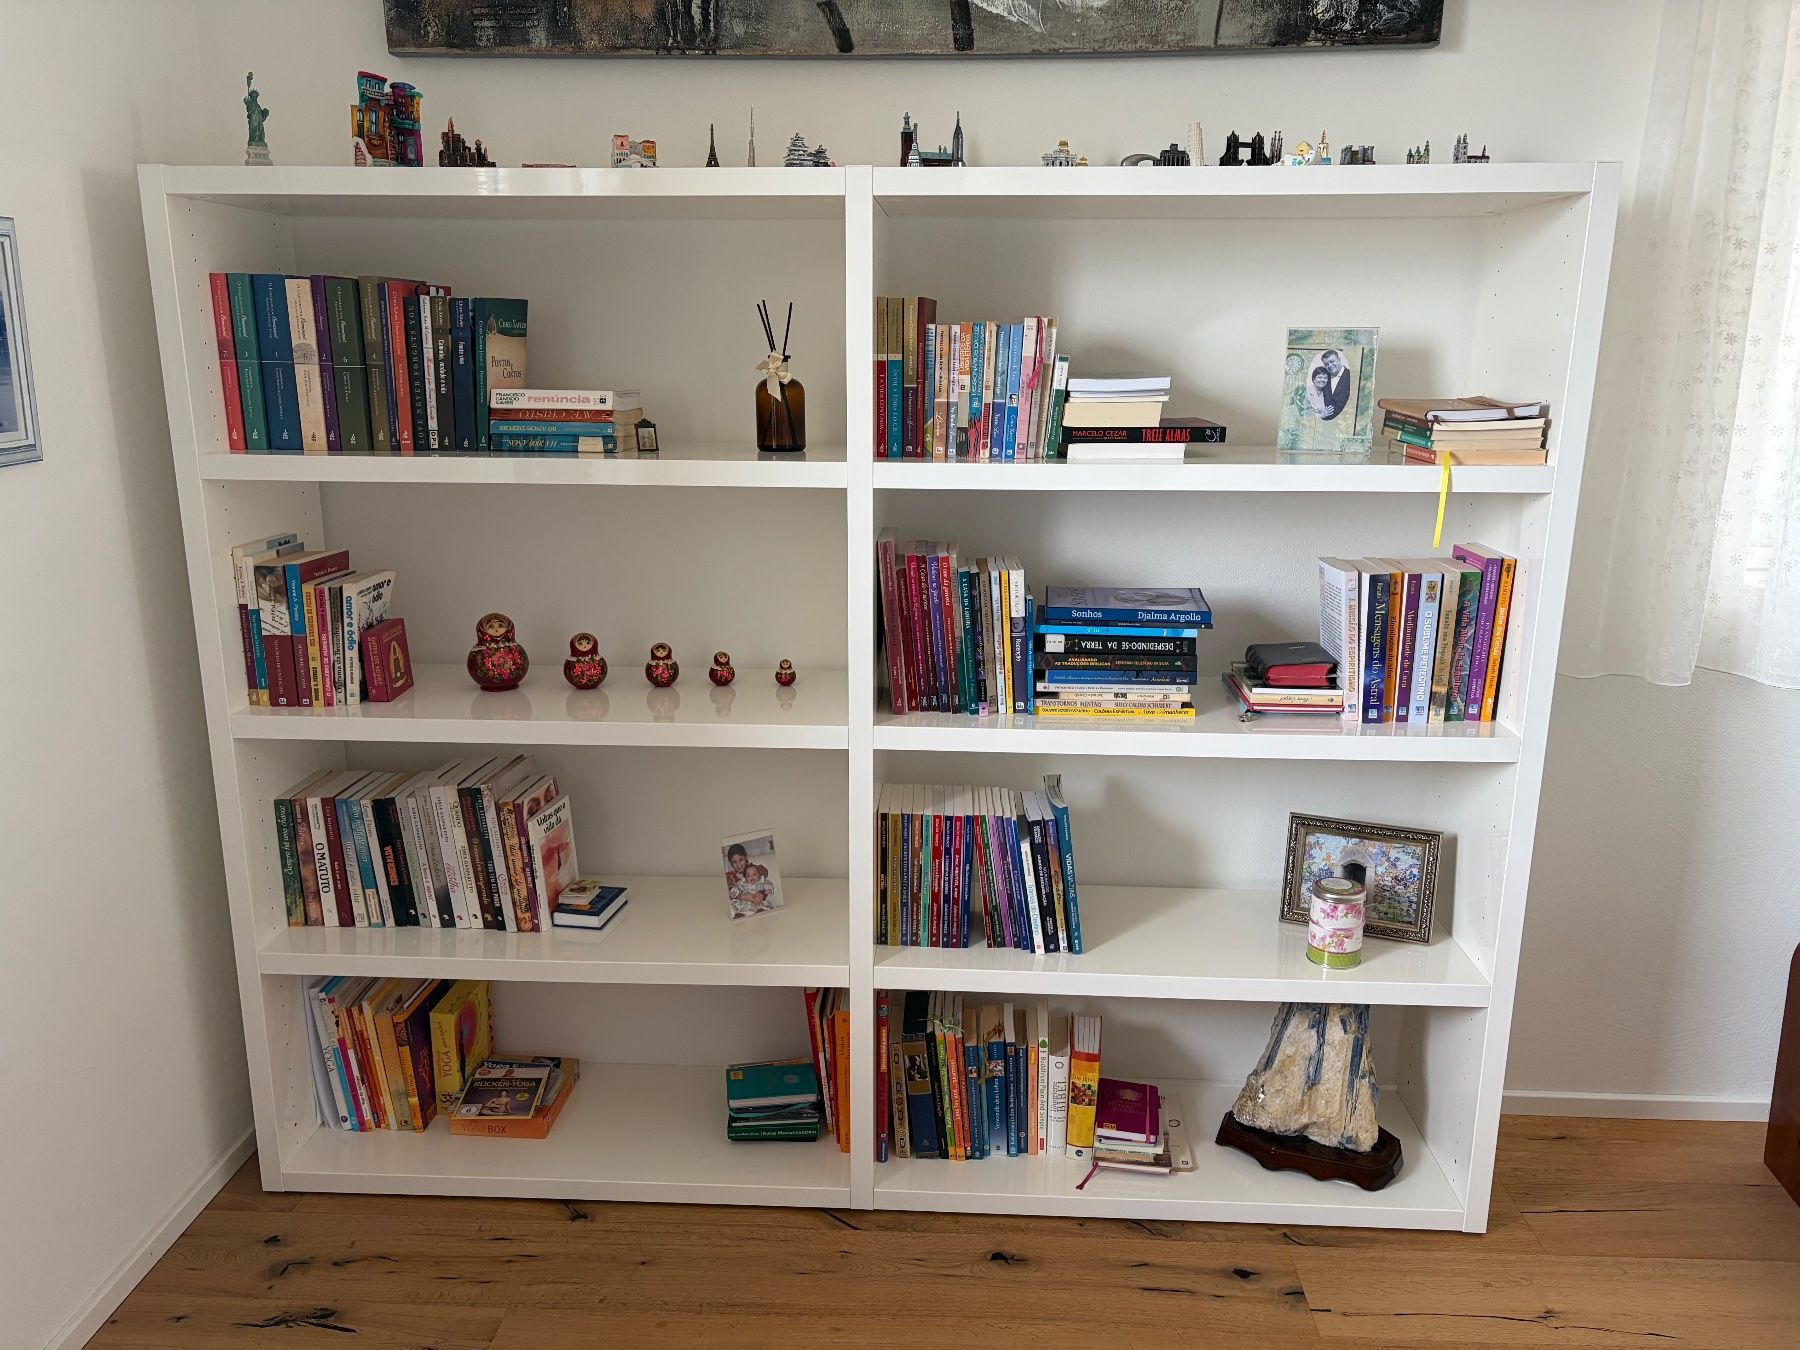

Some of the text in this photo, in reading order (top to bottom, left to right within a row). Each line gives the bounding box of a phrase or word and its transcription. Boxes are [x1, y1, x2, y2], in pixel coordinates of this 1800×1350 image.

[408, 305, 416, 325] YOU
[527, 394, 591, 404] renúncia
[1142, 429, 1190, 442] TREZE ALMAS
[1071, 609, 1201, 623] Sonhos Djalma Argollo
[346, 630, 358, 652] ódio
[1080, 640, 1174, 651] DESPEDINDO-SE DA TERRA
[1401, 610, 1415, 688] Mediunidade de Cura
[335, 657, 342, 665] da
[1369, 603, 1386, 705] Mensagens do Astral
[1416, 611, 1433, 701] O SUBLIME PEREGRINO
[1348, 646, 1357, 693] ESPIRITISMO
[315, 842, 331, 894] O MATUTO
[1065, 852, 1073, 875] VIDAS
[1032, 914, 1041, 936] Destino
[323, 1045, 335, 1073] YOGA
[442, 1050, 453, 1078] YOGA
[1039, 1056, 1048, 1083] Buddhism
[474, 1080, 536, 1088] RÜCKEN-YOGA
[1039, 1084, 1047, 1099] Plain
[1057, 1080, 1067, 1113] BIBEL
